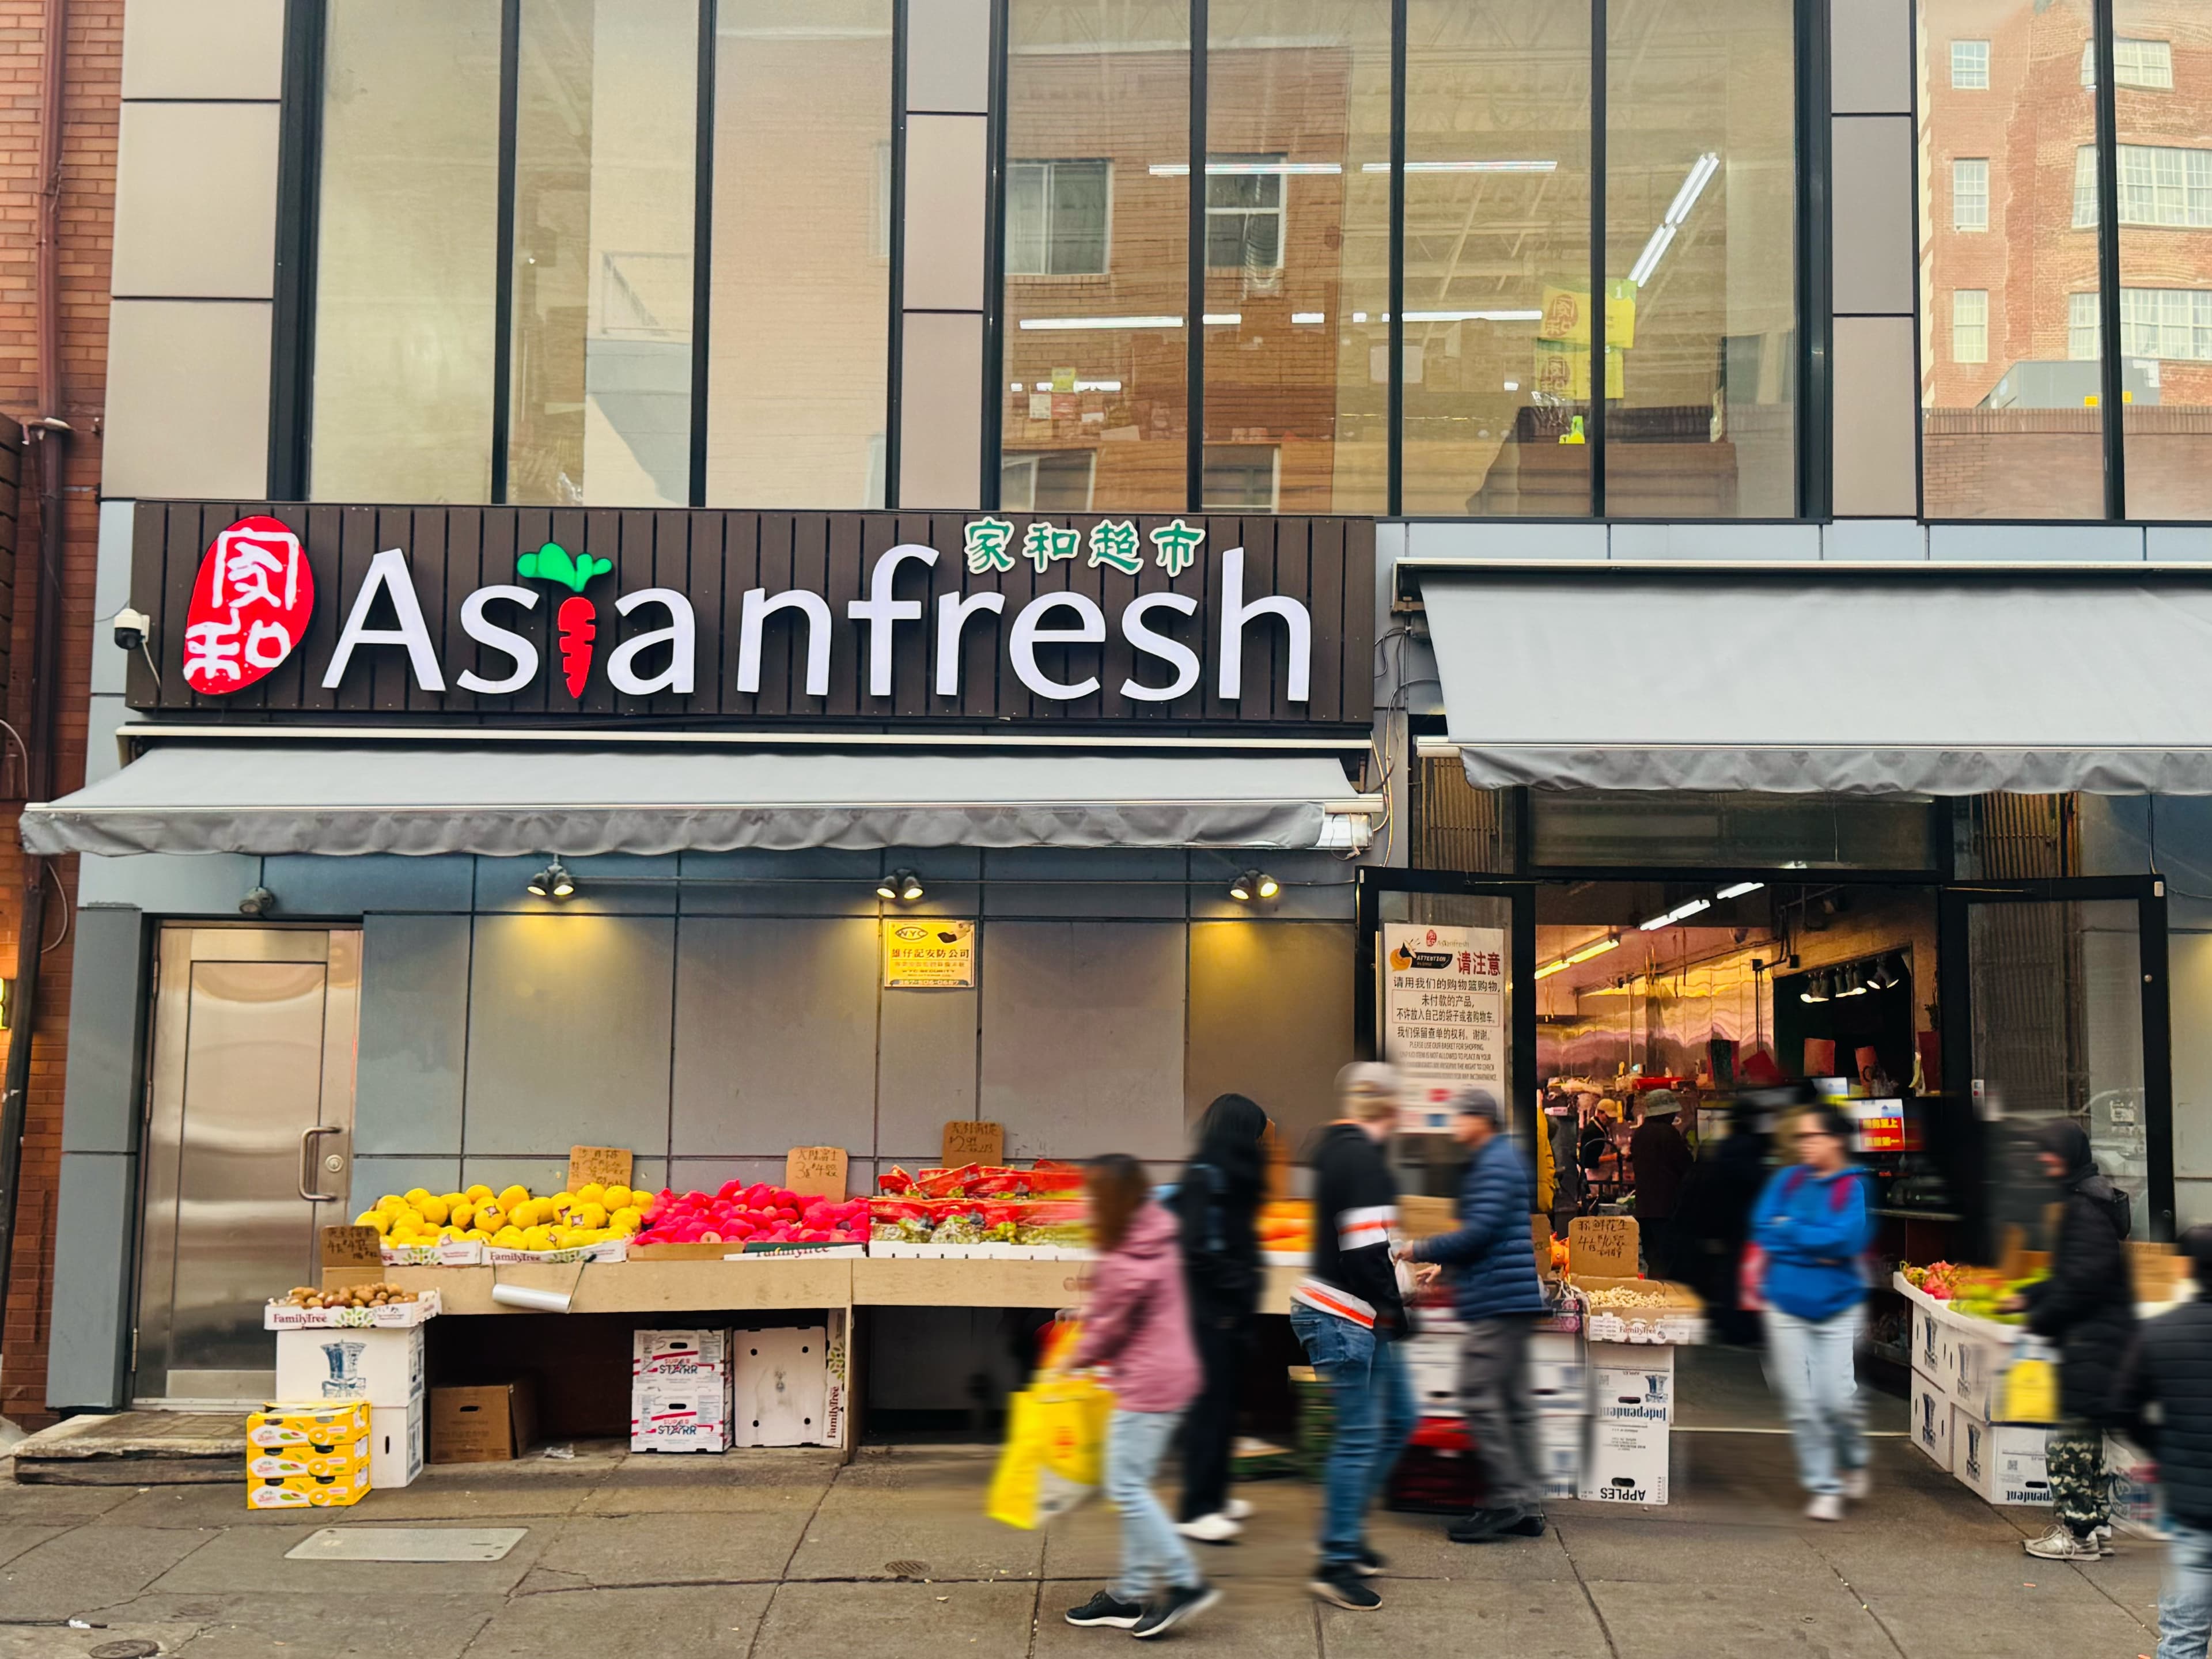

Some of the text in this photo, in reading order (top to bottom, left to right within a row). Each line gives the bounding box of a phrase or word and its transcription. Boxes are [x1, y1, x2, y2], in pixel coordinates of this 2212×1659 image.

[964, 516, 1205, 577] 家和超市
[1457, 950, 1501, 976] 请注意
[490, 1251, 541, 1263] FamilyTree
[274, 1313, 327, 1324] FamilyTree
[827, 1386, 839, 1439] FamilyTree
[1600, 1488, 1646, 1501] APPLES
